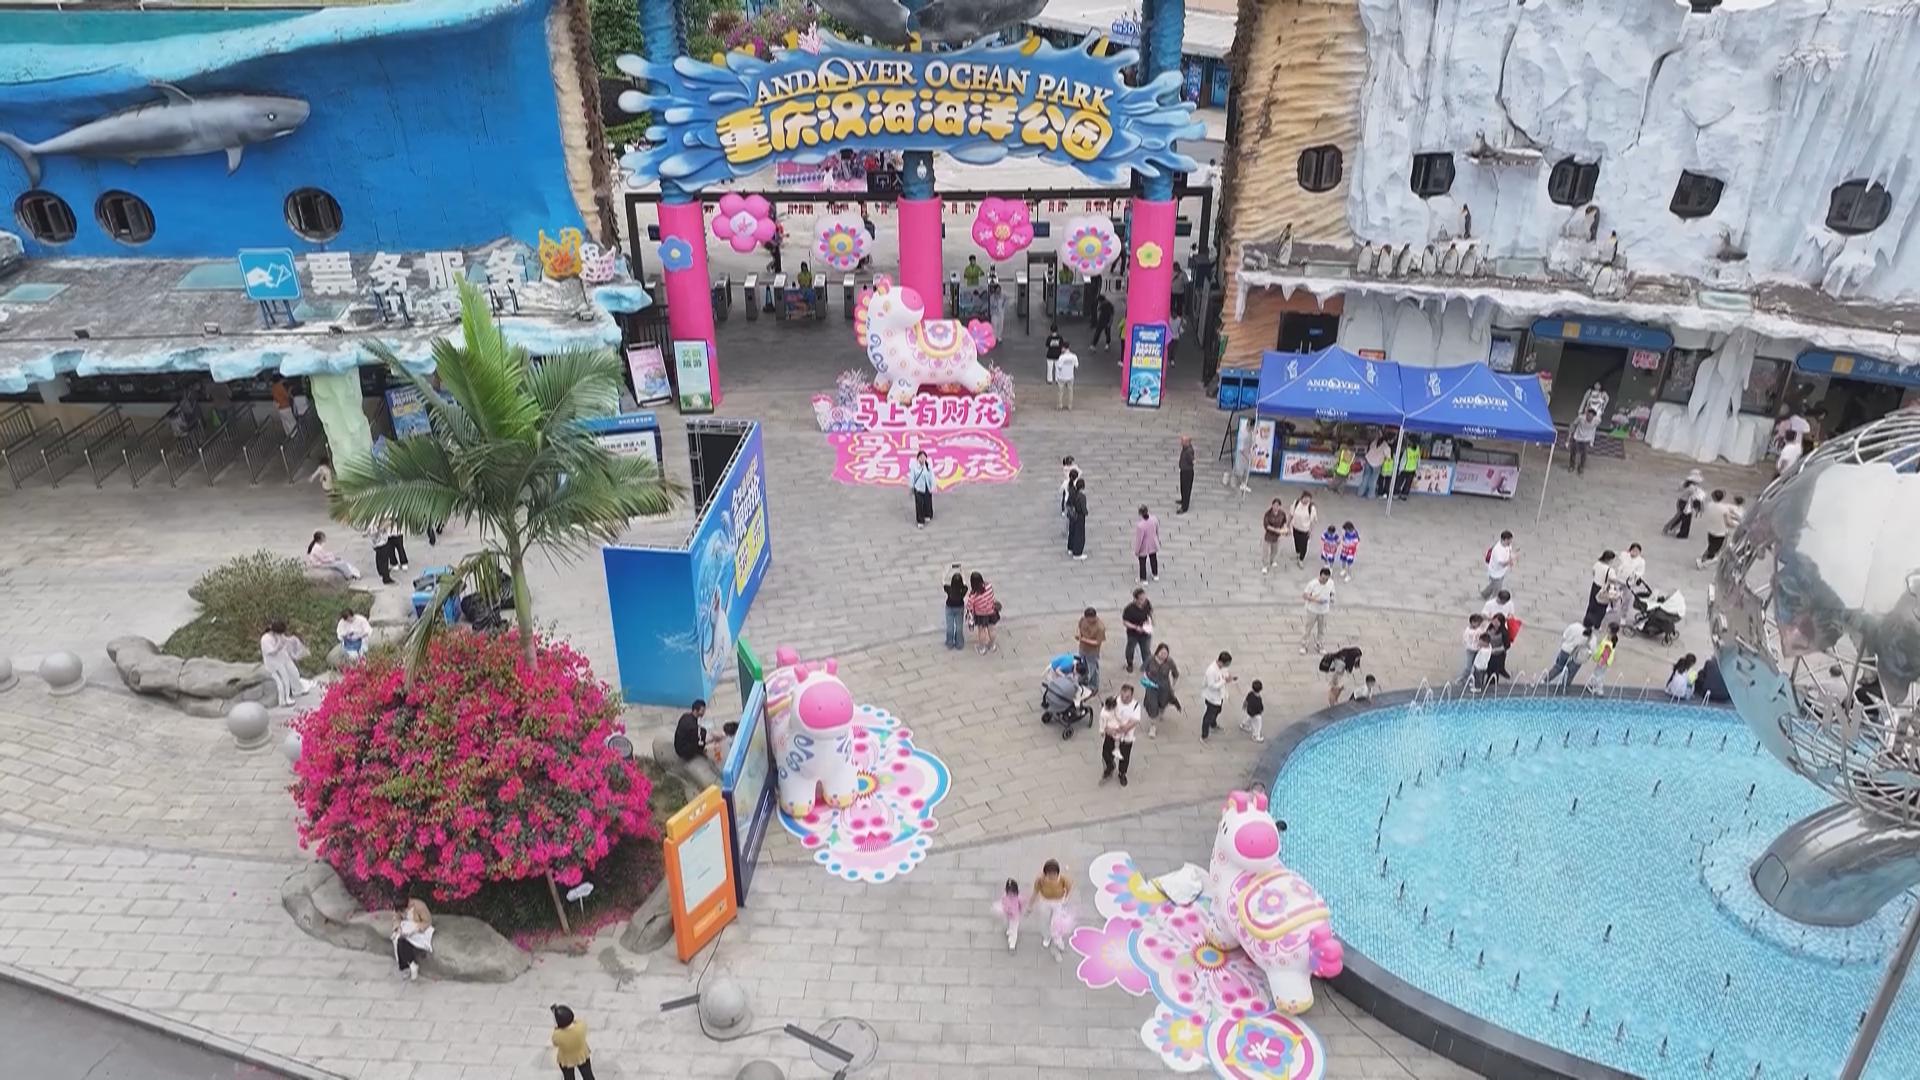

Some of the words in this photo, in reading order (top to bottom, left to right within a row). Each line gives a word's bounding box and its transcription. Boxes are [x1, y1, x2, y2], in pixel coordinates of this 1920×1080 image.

[754, 57, 917, 107] ANDOVER
[924, 60, 1031, 96] OCEAN
[1035, 73, 1113, 116] PARK
[716, 88, 1113, 164] 重庆汉海海洋公园
[305, 249, 525, 296] 票务服务
[1307, 377, 1360, 390] ANDOVER
[856, 395, 1001, 428] 马上有财花
[1452, 394, 1508, 407] ANDOVER
[855, 434, 936, 459] 马上
